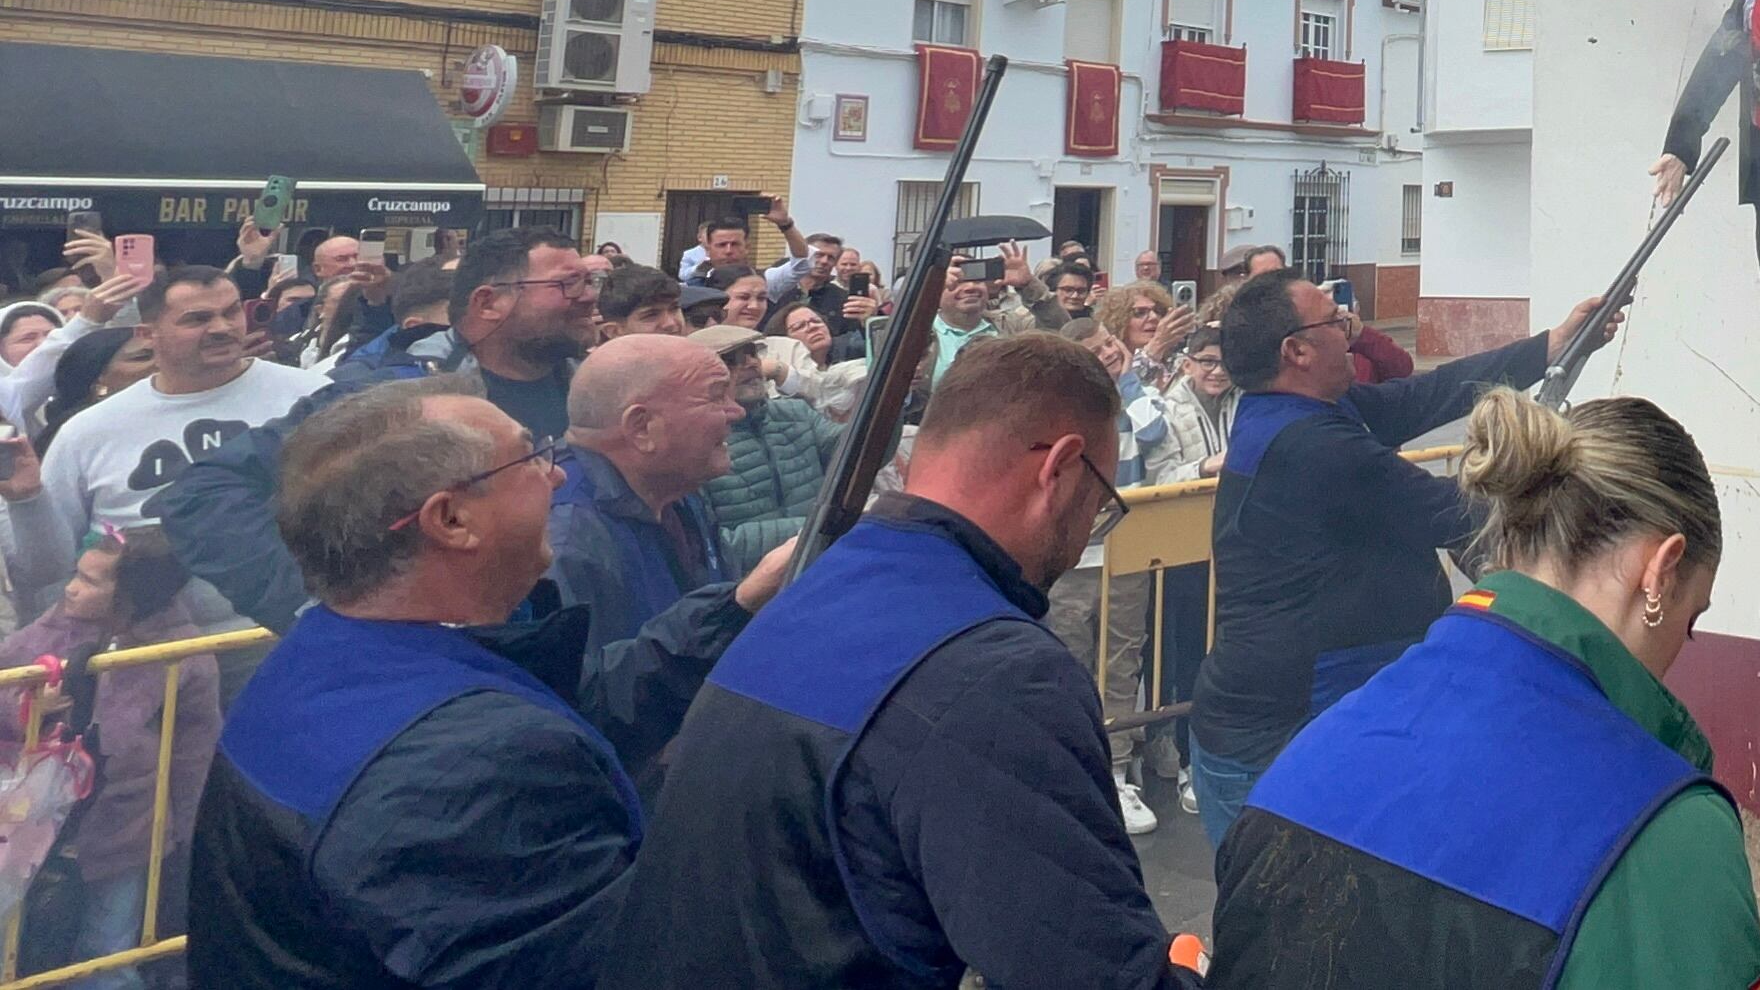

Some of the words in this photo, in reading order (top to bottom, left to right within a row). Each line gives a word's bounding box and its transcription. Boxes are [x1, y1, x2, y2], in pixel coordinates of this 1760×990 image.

[160, 197, 207, 222] BAR
[222, 198, 309, 223] PAOR
[367, 197, 451, 214] Cruzcampo
